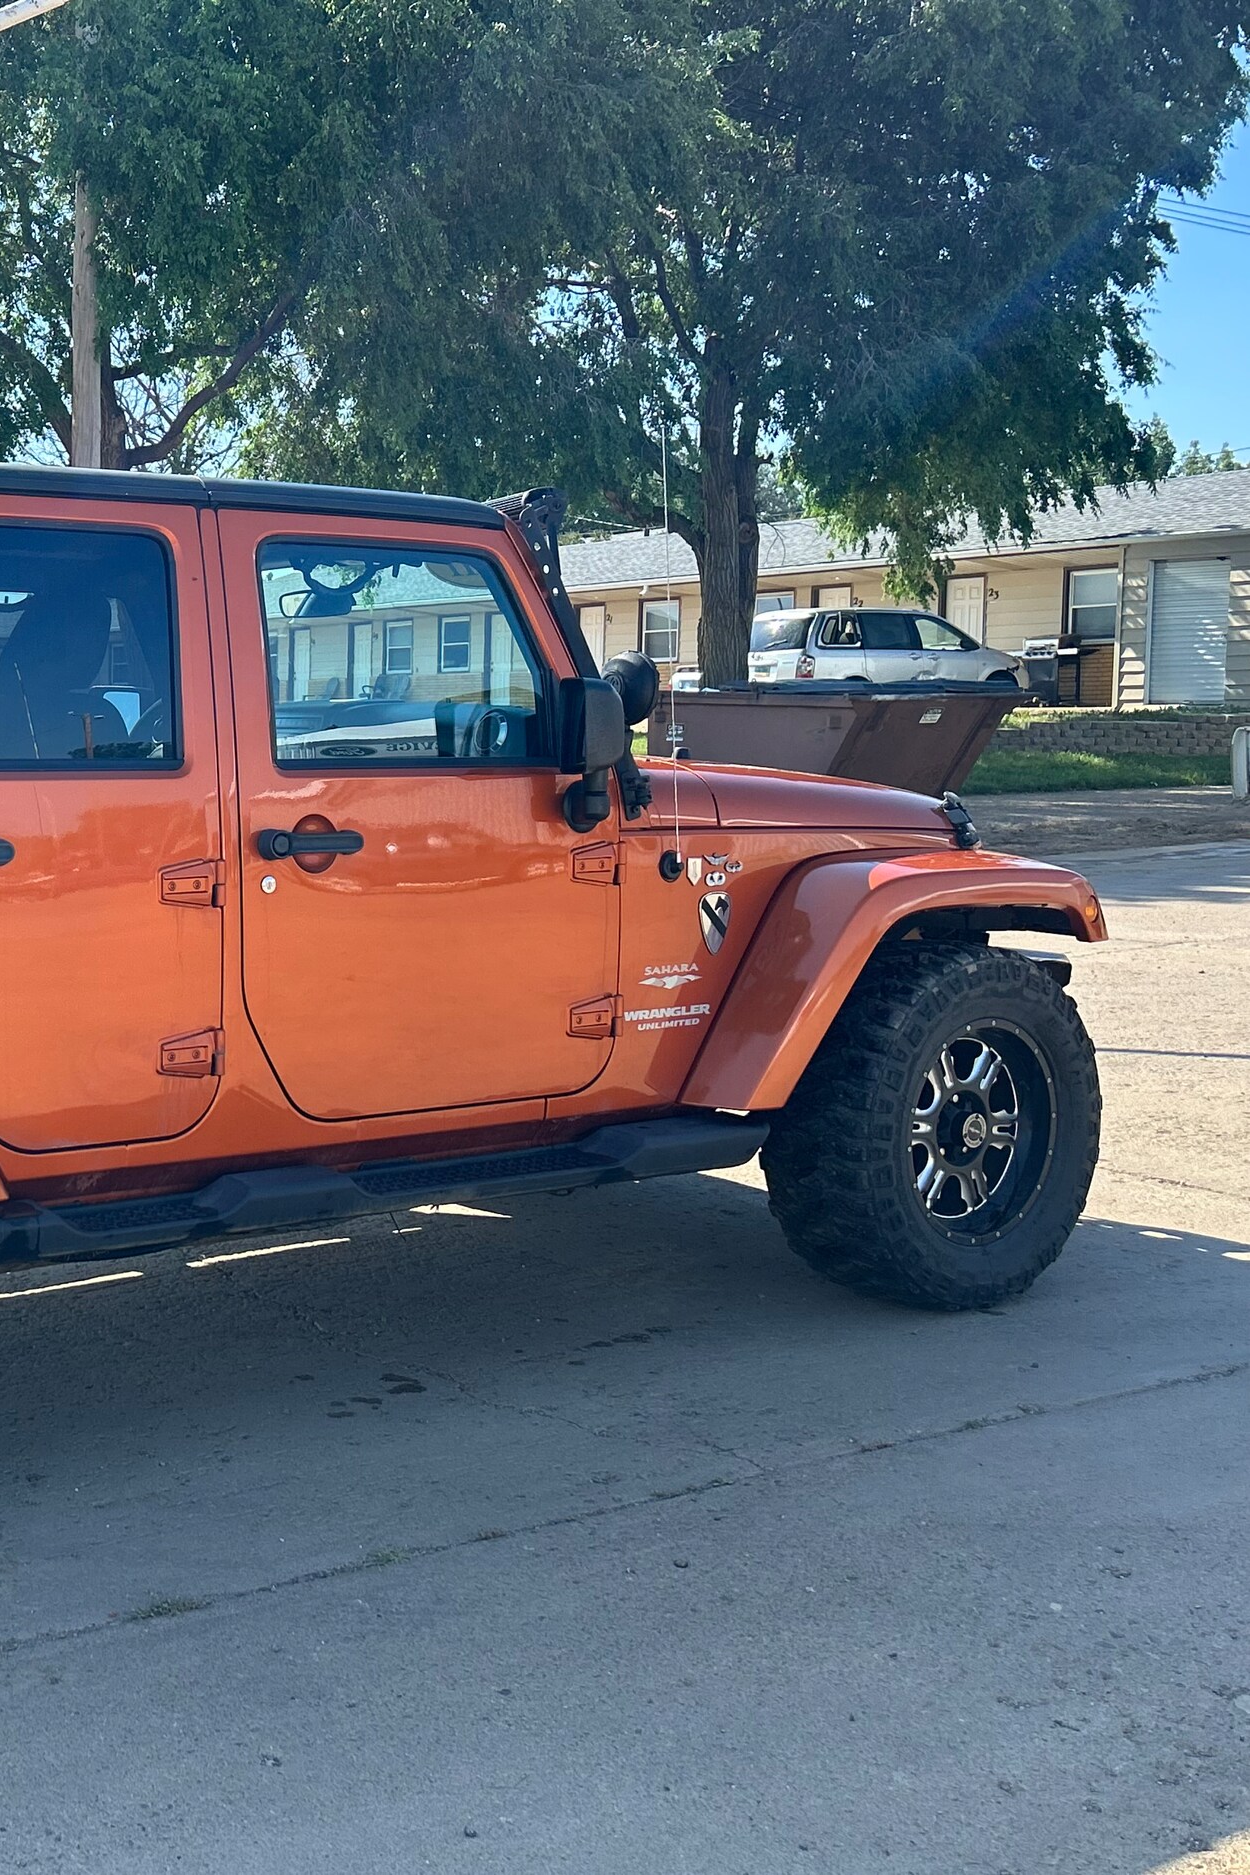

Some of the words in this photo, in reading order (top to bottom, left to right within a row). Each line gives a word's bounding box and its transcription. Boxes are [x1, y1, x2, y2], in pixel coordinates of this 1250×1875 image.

[988, 588, 1000, 600] 23
[853, 597, 864, 607] 22
[644, 962, 699, 976] SAHARA
[624, 1003, 711, 1022] WRANGLER
[637, 1018, 700, 1031] UNLIMITED
